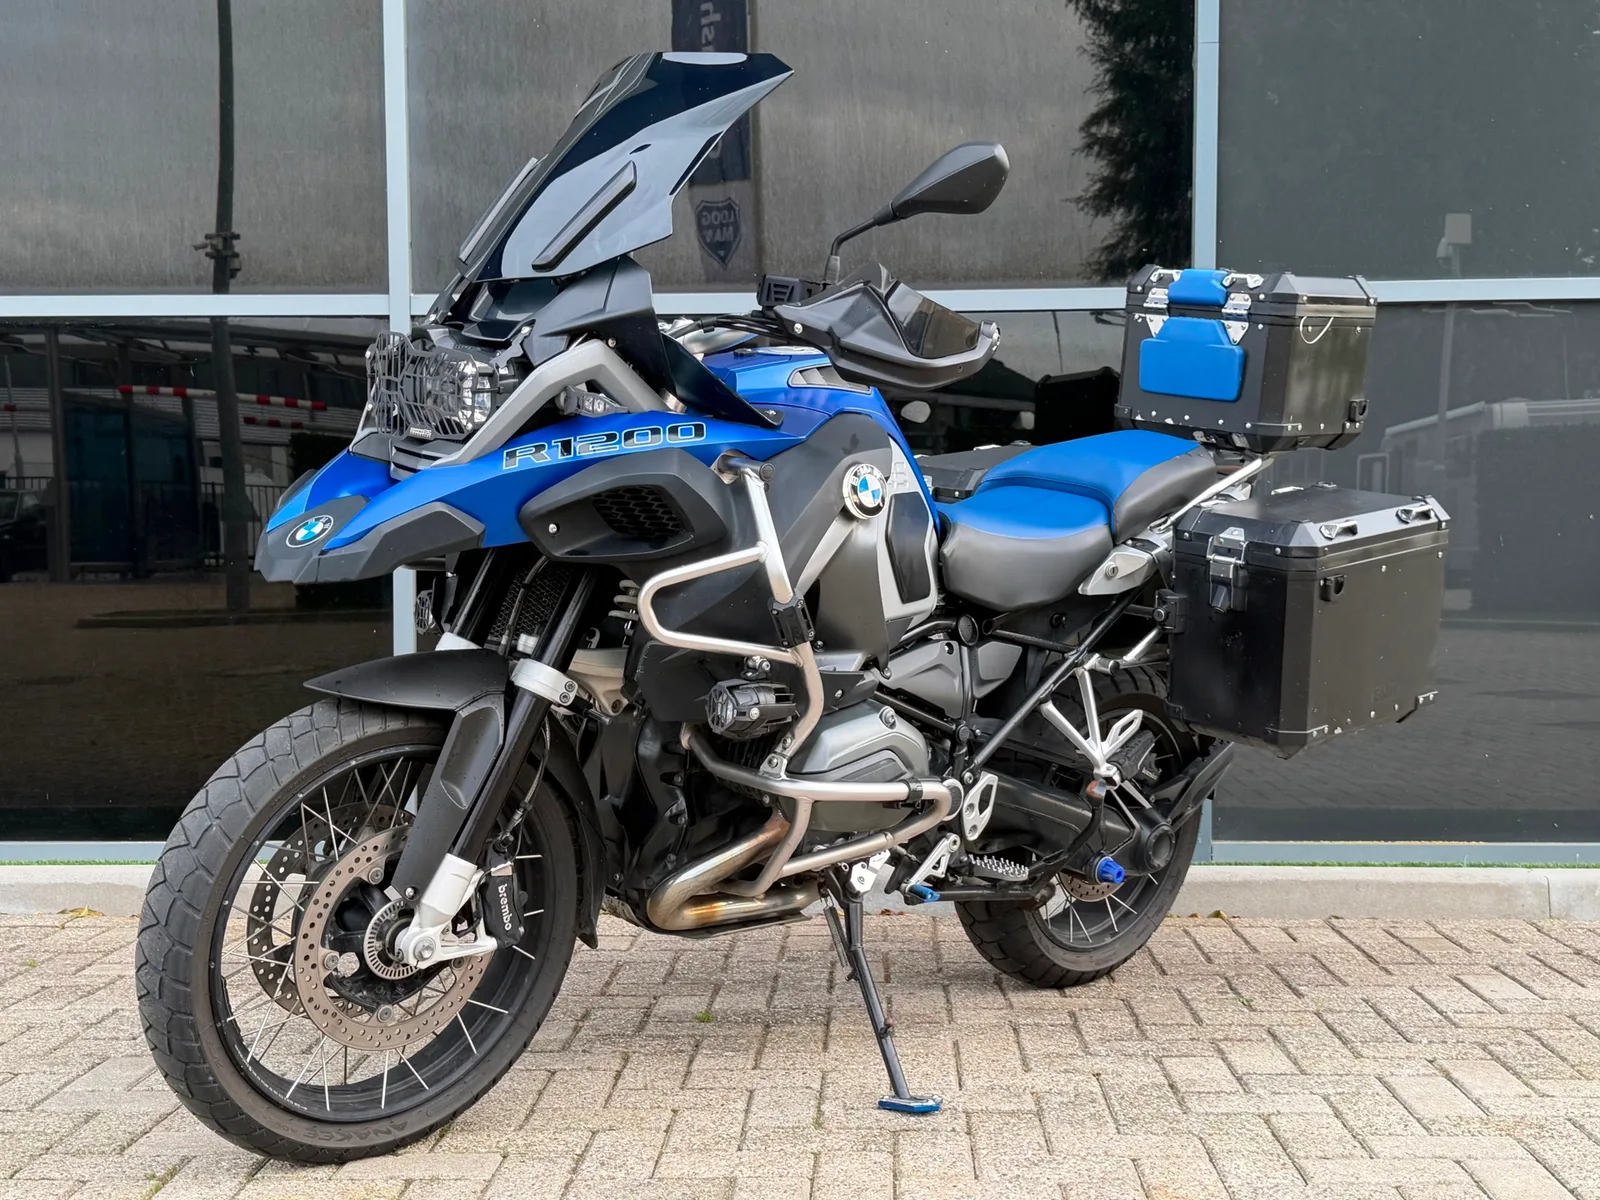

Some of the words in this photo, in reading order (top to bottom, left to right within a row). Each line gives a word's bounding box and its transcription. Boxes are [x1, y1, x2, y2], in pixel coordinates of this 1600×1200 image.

[502, 421, 707, 470] R1200
[498, 883, 513, 931] brembo
[303, 1120, 409, 1142] ANAKEE
